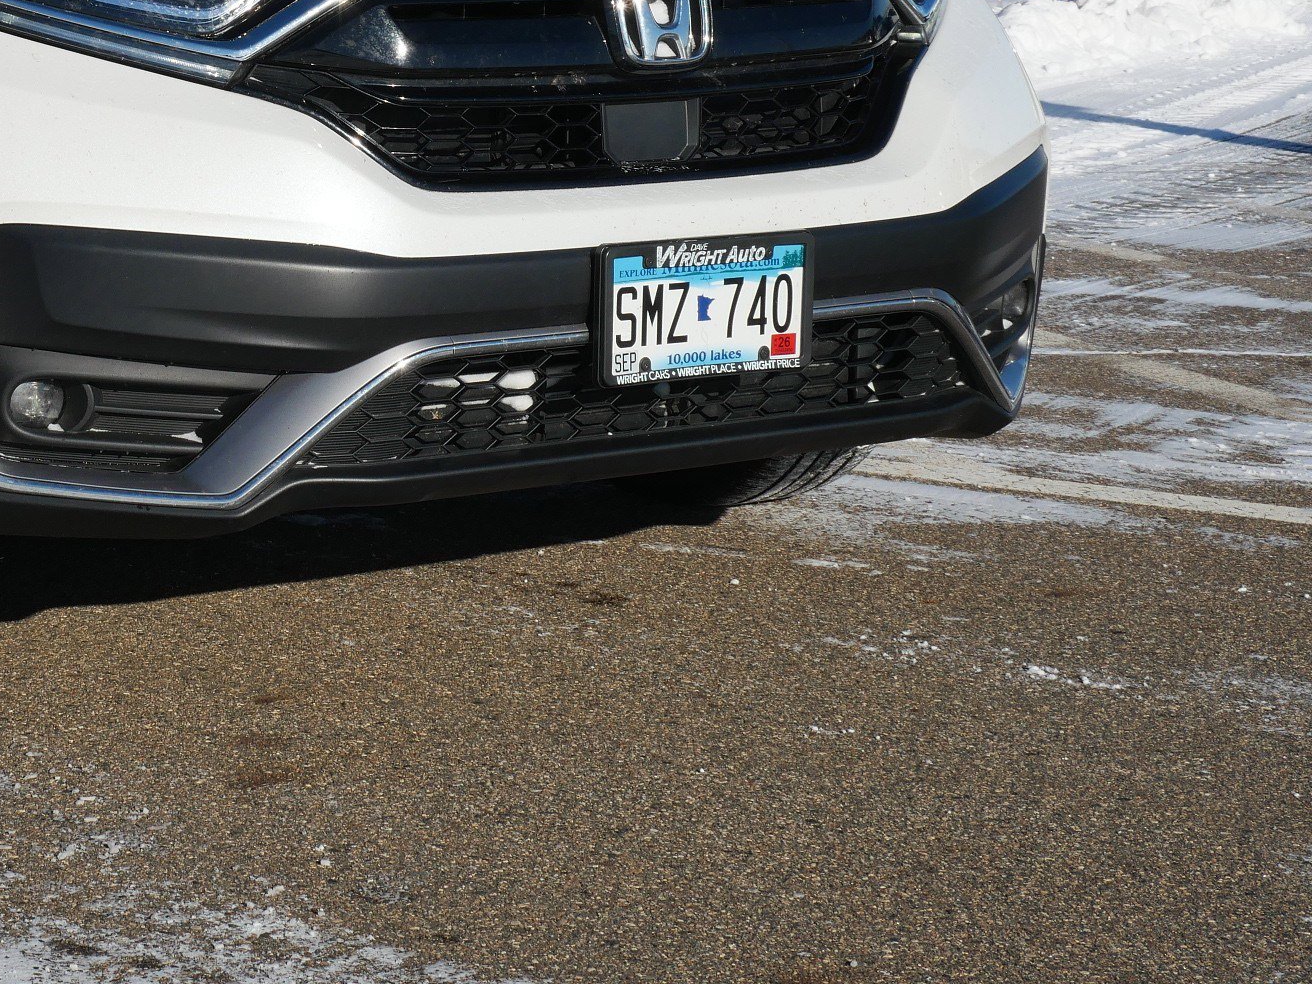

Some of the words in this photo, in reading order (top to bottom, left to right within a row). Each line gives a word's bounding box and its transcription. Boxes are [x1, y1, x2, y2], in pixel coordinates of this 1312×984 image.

[656, 242, 727, 268] WRIGHT
[726, 245, 766, 263] Auto
[690, 242, 709, 252] DAVE
[619, 268, 657, 278] EXPLORE
[615, 281, 690, 349] SMZ
[723, 273, 793, 339] 740
[777, 336, 791, 348] 26
[614, 351, 637, 373] SEP
[667, 351, 707, 366] 10,000
[710, 349, 742, 361] lakes
[616, 372, 648, 385] WRIGHT
[648, 369, 671, 381] CARS
[676, 366, 710, 378] WRIGHT
[710, 362, 737, 374] PLACE
[742, 359, 776, 371] WRIGHT
[776, 358, 801, 369] PRICE
